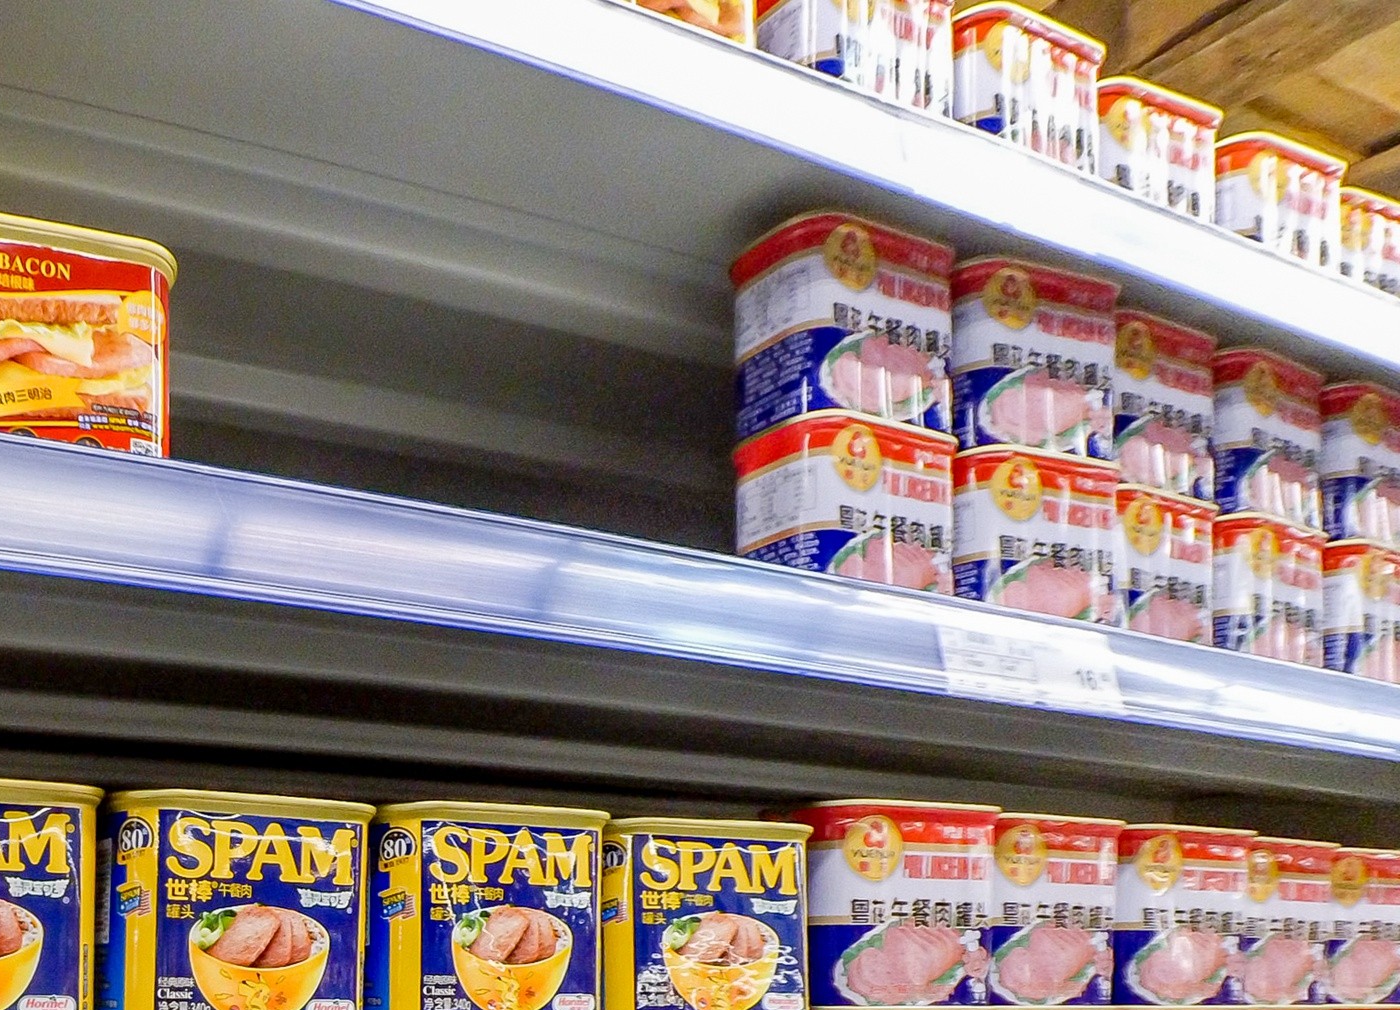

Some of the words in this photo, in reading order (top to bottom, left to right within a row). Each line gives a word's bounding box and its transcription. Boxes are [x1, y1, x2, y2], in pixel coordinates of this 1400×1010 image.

[121, 827, 142, 850] 80
[384, 840, 407, 857] 80
[165, 817, 355, 885] SPAM
[429, 826, 592, 887] SPAM
[640, 838, 798, 897] SPAM
[165, 878, 212, 901] 世棒
[429, 884, 469, 905] 世棒
[640, 891, 681, 911] 世棒
[166, 904, 195, 919] 罐头
[157, 988, 194, 1000] Classic
[422, 985, 456, 997] Classic
[26, 999, 68, 1009] Hormel
